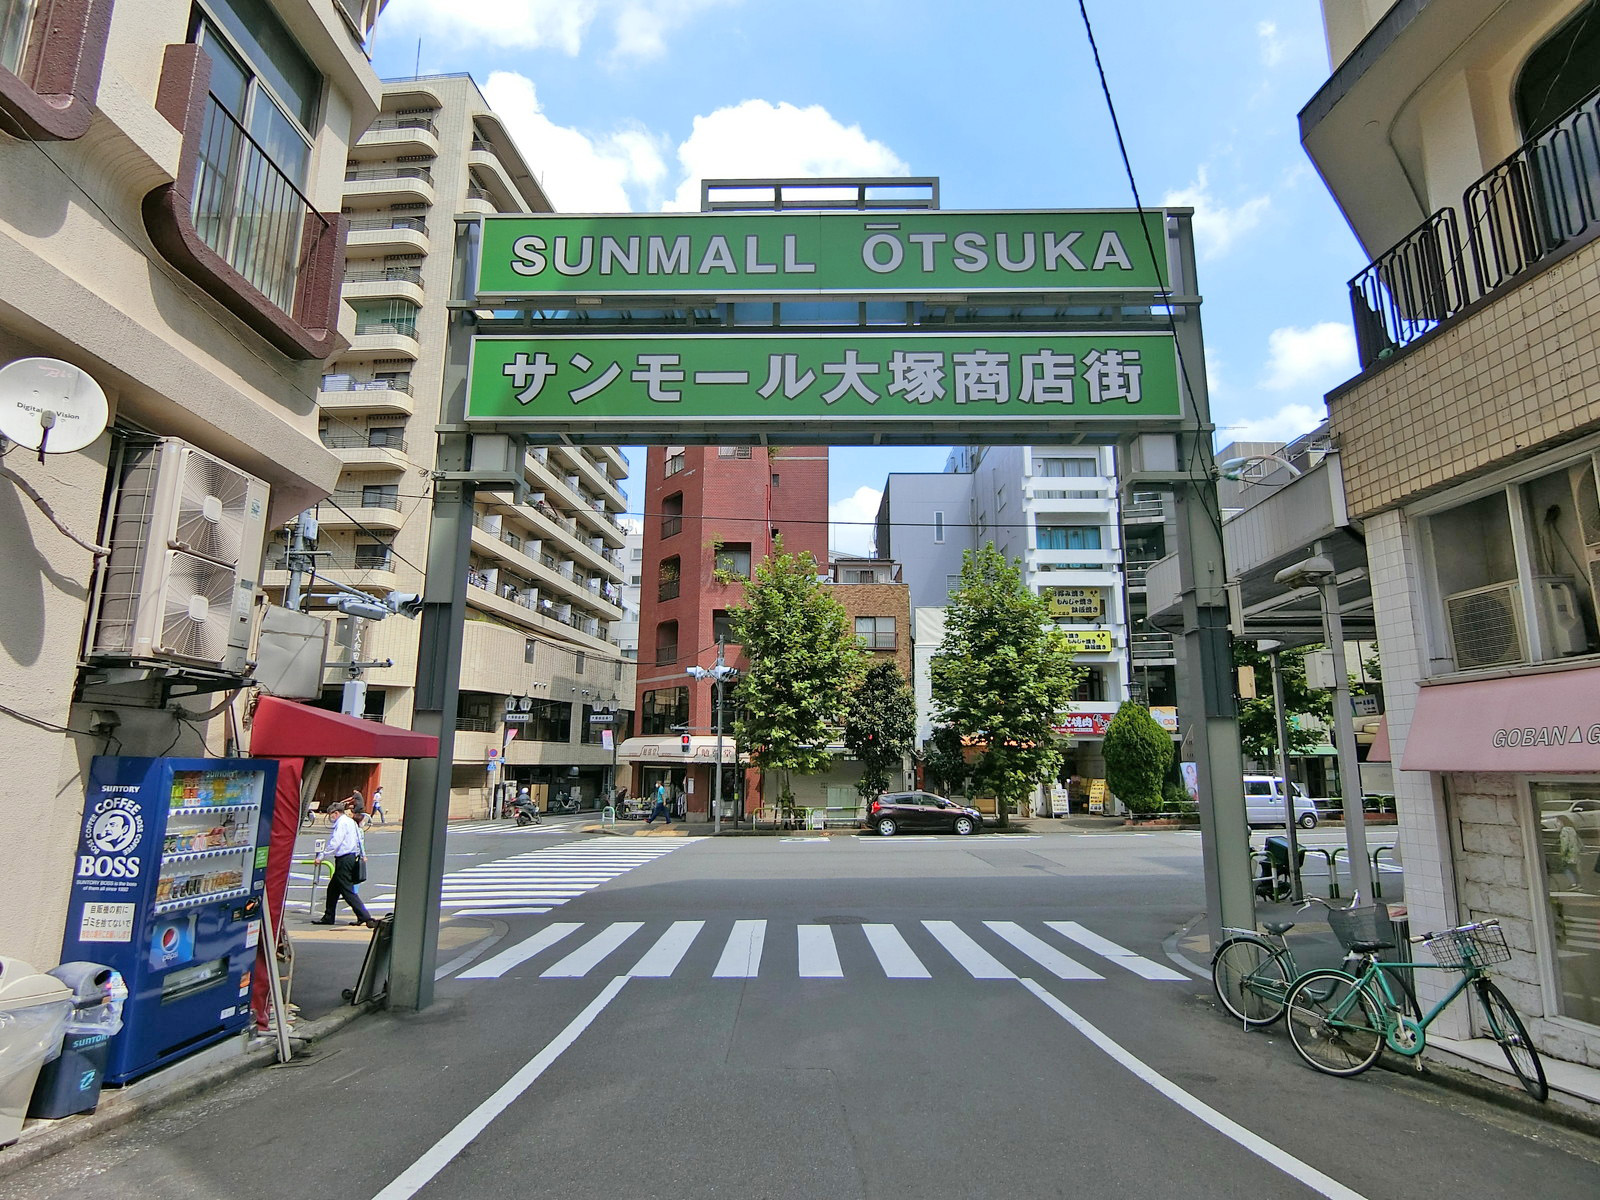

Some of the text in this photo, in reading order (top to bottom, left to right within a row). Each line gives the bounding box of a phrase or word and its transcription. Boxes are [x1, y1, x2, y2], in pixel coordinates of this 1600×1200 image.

[510, 223, 1134, 276] SUNMALL ŌTSUKA
[502, 349, 1143, 405] サンモール大塚商店街
[16, 402, 80, 420] Digital Vision
[101, 785, 140, 793] SUNTORY
[95, 797, 142, 815] COFFEE
[77, 855, 141, 878] BOSS
[83, 916, 131, 928] ゴミを捨てないで
[162, 951, 178, 962] pepsi
